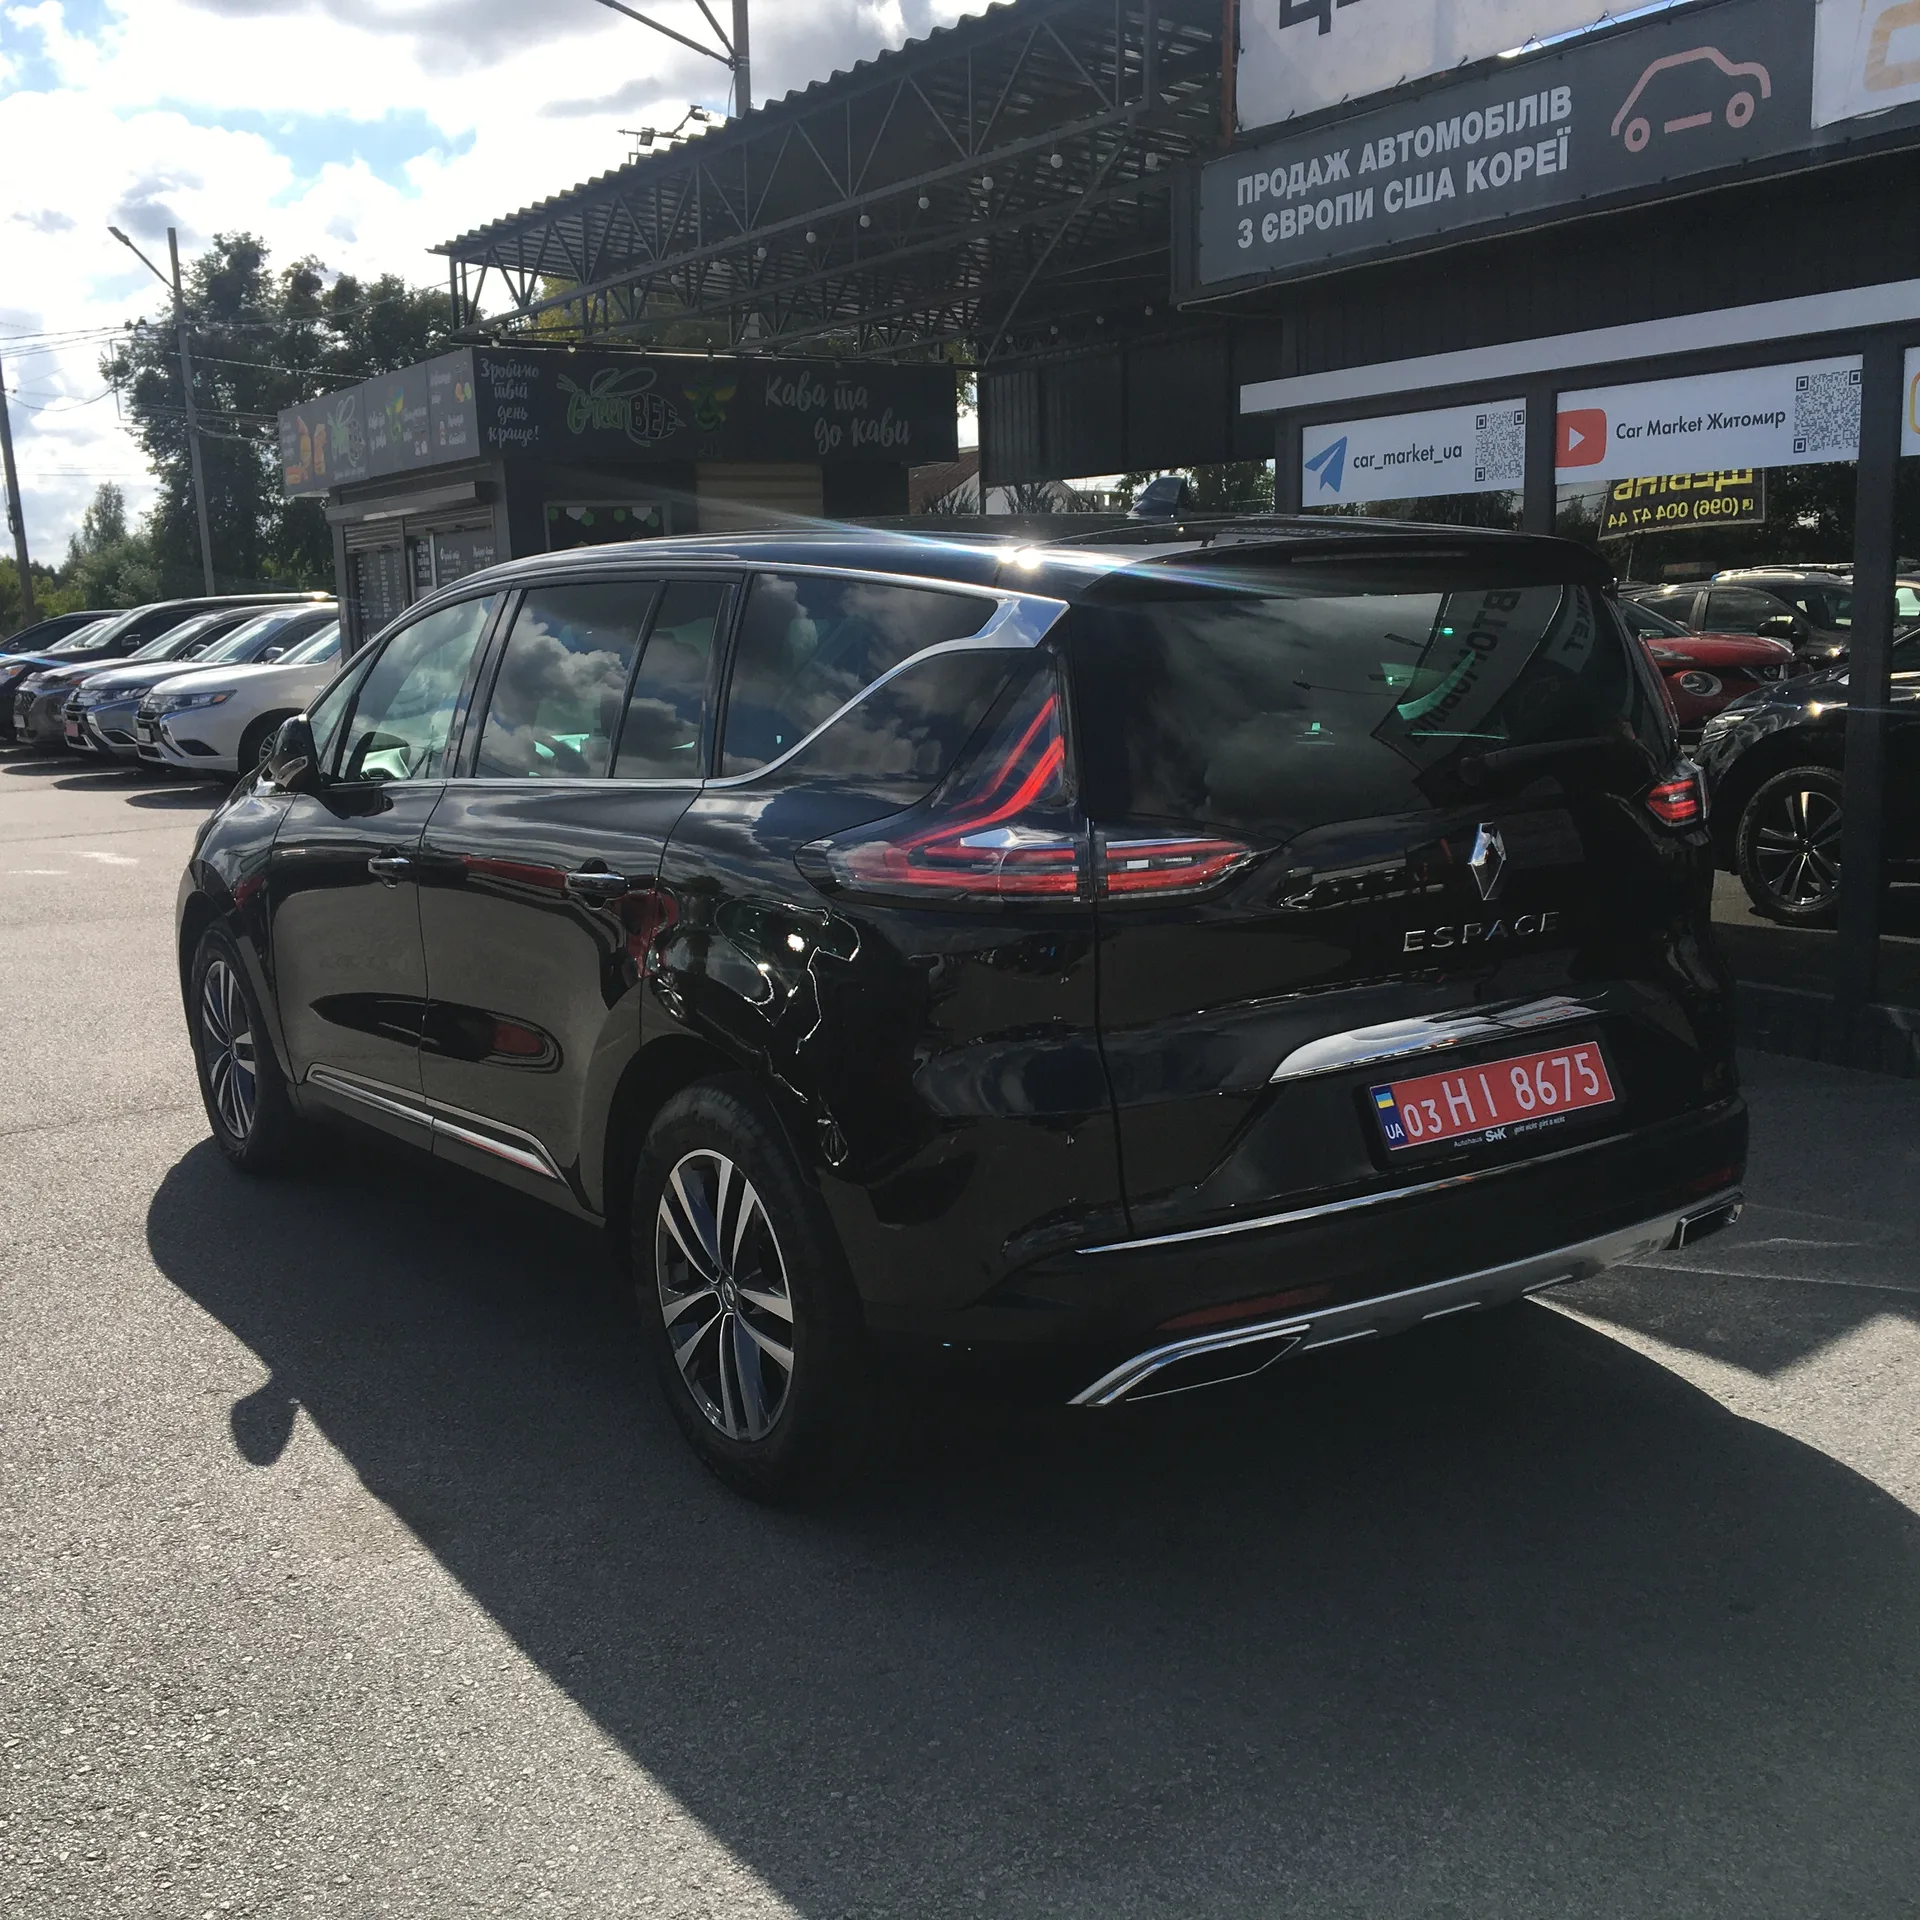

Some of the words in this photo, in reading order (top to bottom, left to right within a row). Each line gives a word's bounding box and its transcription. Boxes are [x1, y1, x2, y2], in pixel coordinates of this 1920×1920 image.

[1237, 148, 1351, 207] ПРОДАЖ
[1358, 85, 1573, 175] АВТОМОБІЛІВ
[1237, 217, 1254, 249] З
[1261, 186, 1374, 243] ЄВРОПИ
[1383, 167, 1456, 214] США
[1466, 126, 1572, 194] КОРЕЇ
[480, 357, 540, 380] Зробимо
[493, 381, 528, 400] твій
[764, 370, 828, 412] Кава
[833, 380, 869, 411] та
[497, 404, 529, 425] день
[1616, 422, 1643, 439] Car
[1647, 416, 1703, 437] Market
[1707, 410, 1786, 430] Житомир
[487, 425, 540, 448] краще!
[814, 416, 844, 455] до
[850, 407, 912, 447] кави
[1353, 443, 1462, 470] car_market_ua
[1402, 911, 1560, 953] ESPACE
[1385, 1123, 1405, 1140] UA
[1510, 1051, 1600, 1111] 8675
[1453, 1135, 1483, 1148] Autohaus
